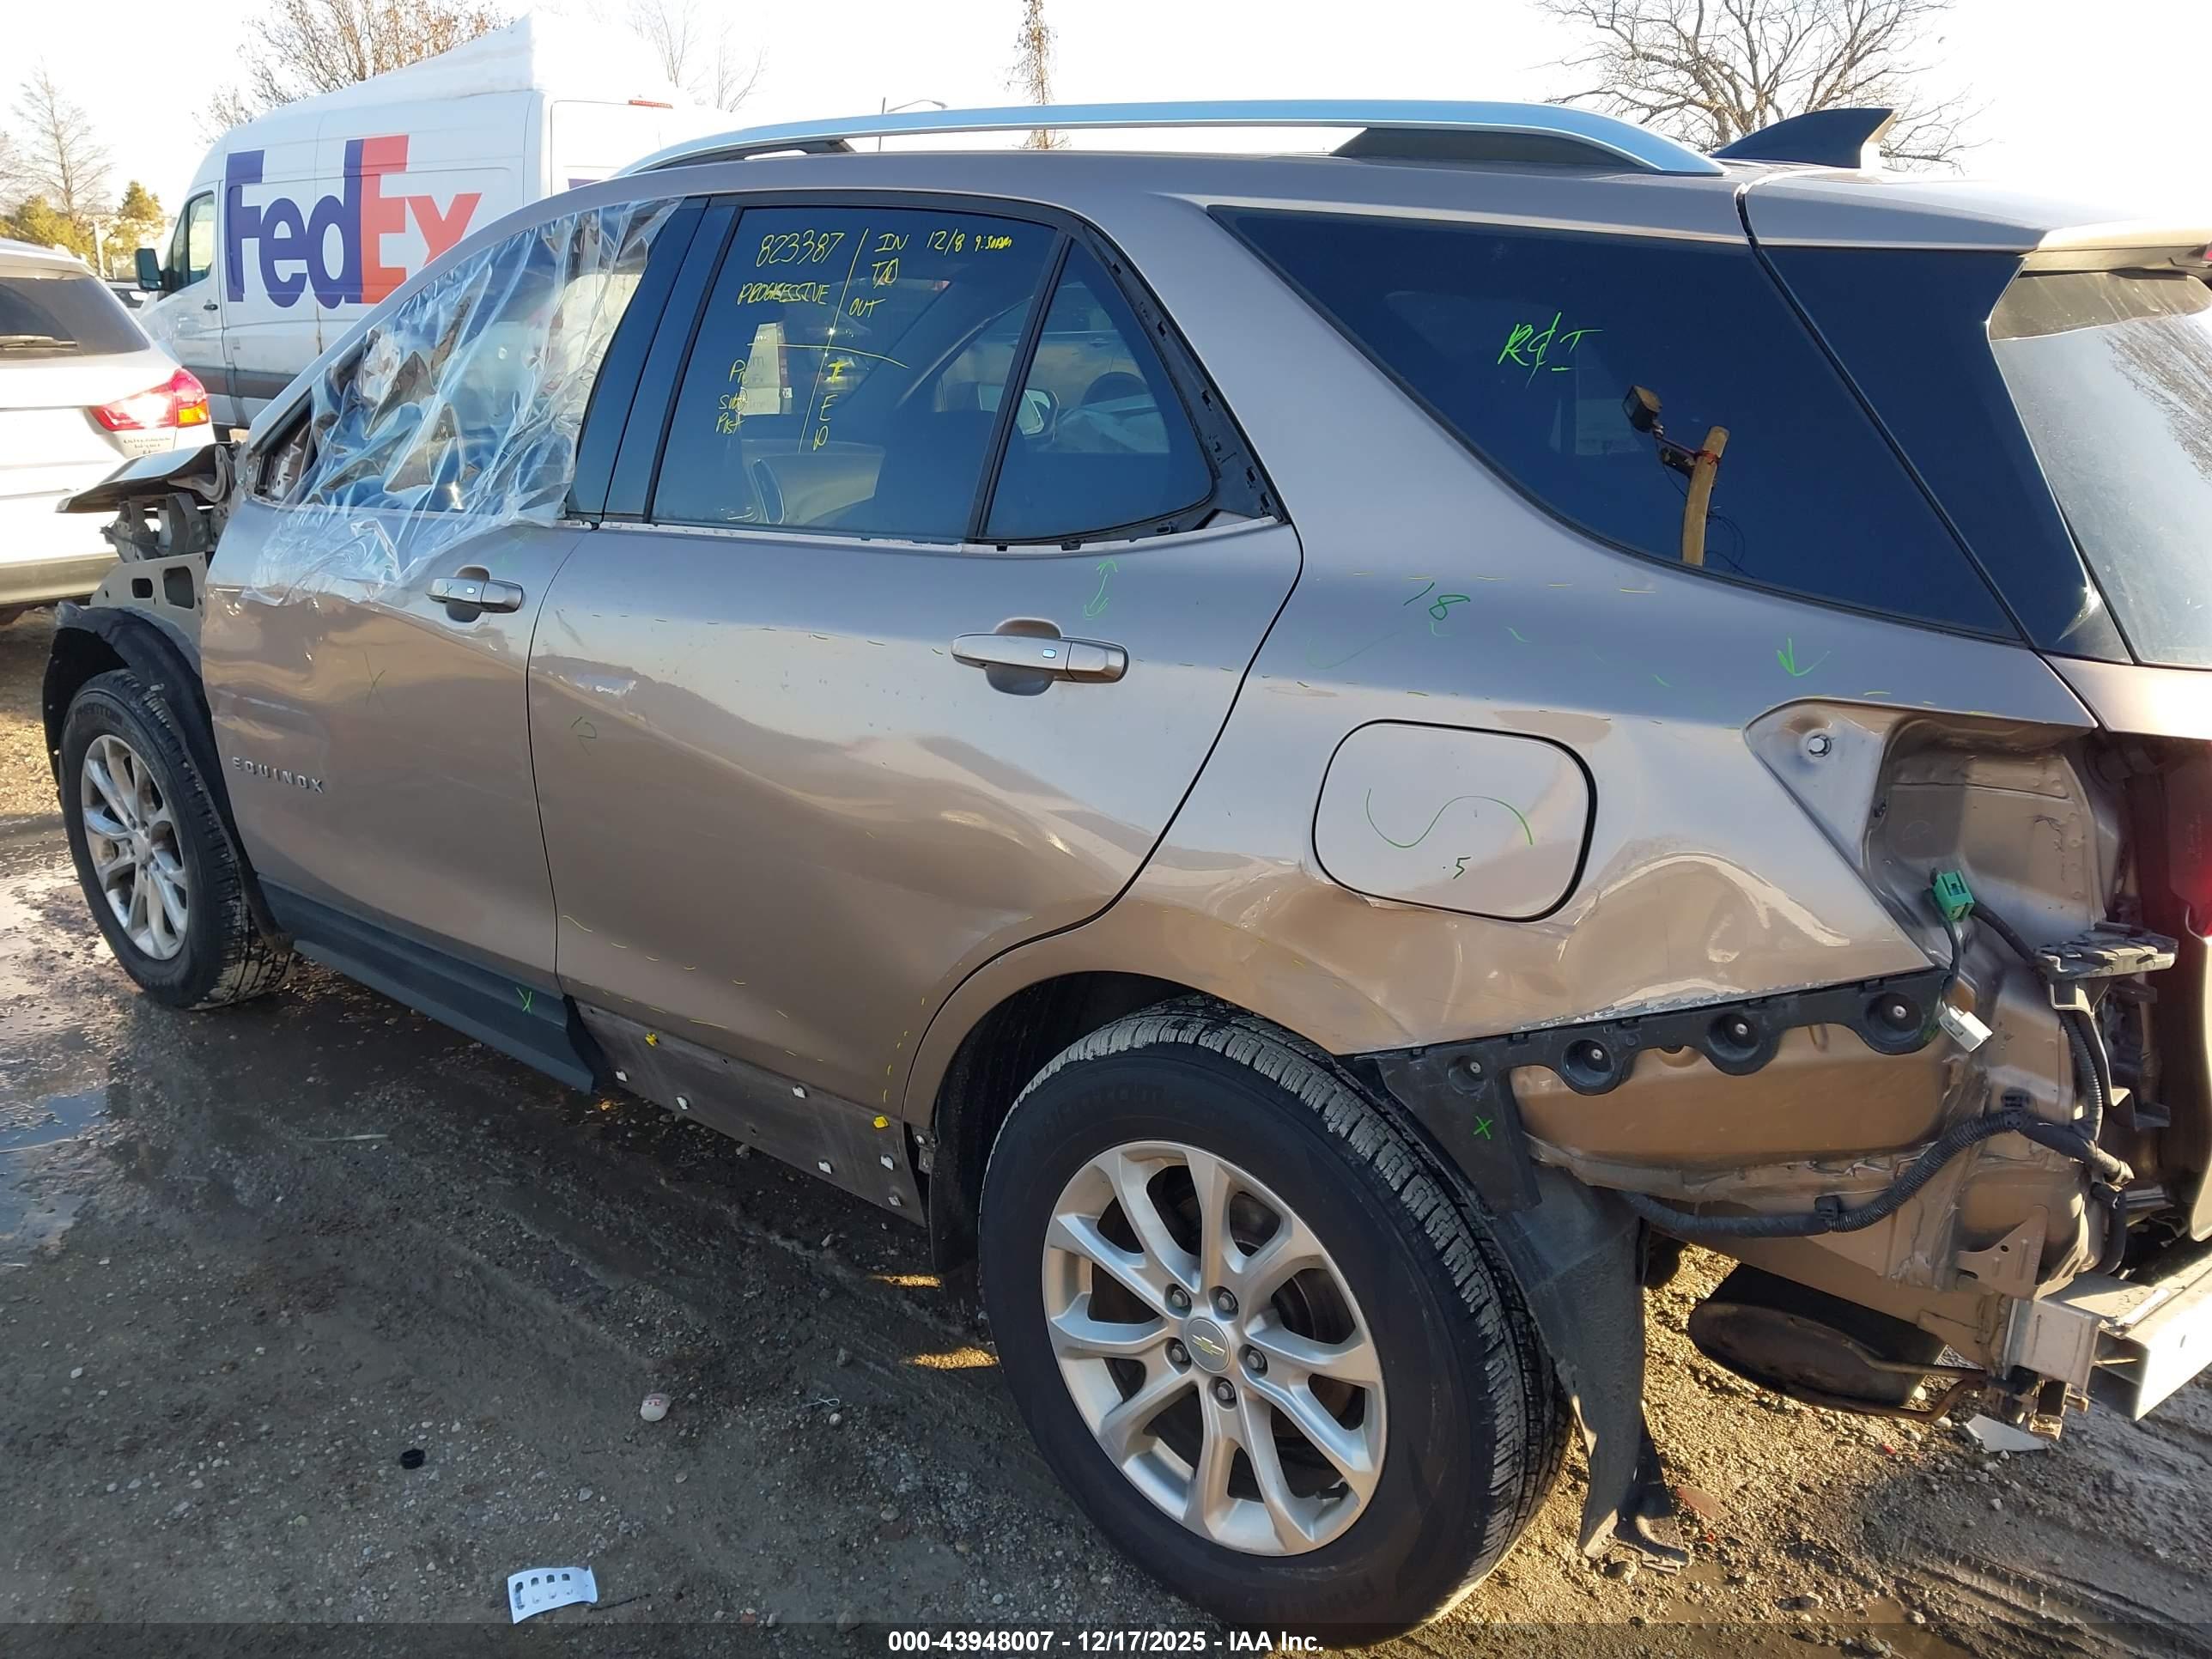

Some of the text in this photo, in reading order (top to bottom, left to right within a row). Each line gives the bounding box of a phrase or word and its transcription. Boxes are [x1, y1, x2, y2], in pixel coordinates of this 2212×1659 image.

[225, 134, 482, 309] FedEx
[756, 229, 845, 267] 823387
[874, 234, 910, 252] IN
[927, 228, 966, 256] 12/8
[848, 299, 886, 318] OUT
[232, 756, 325, 794] EQUINOX
